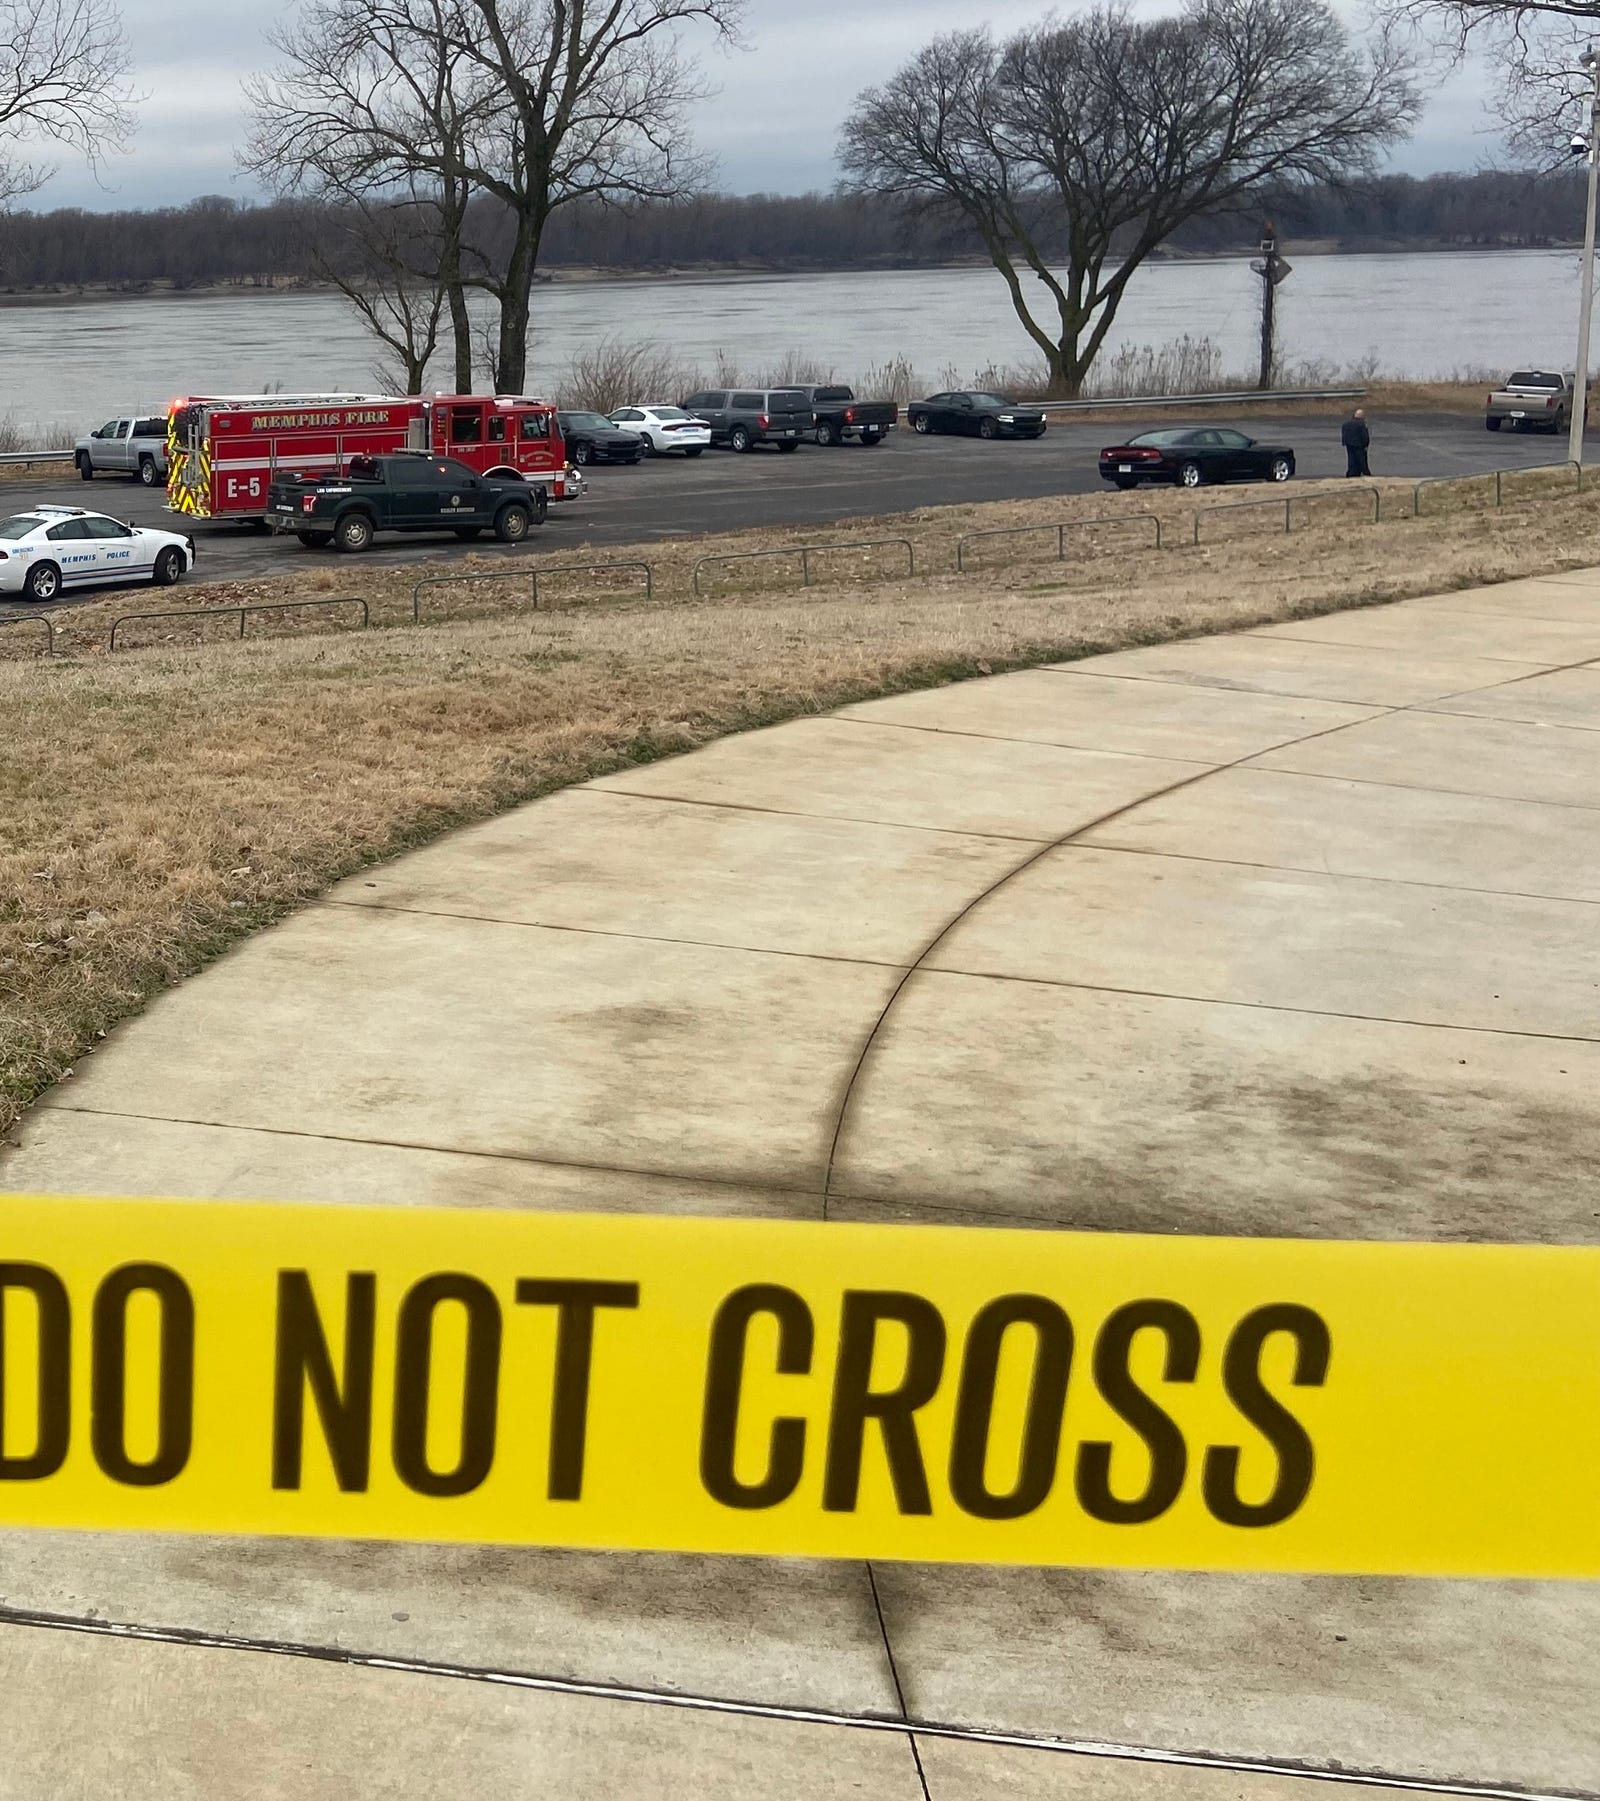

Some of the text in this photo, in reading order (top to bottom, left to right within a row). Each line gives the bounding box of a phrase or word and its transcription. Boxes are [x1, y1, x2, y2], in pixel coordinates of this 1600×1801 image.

[252, 410, 389, 430] MEMPHIS FIRE
[227, 477, 260, 498] E-5
[61, 551, 131, 564] MEMPHIS POLICE
[272, 1271, 640, 1501] NOT
[701, 1285, 1331, 1528] CROSS
